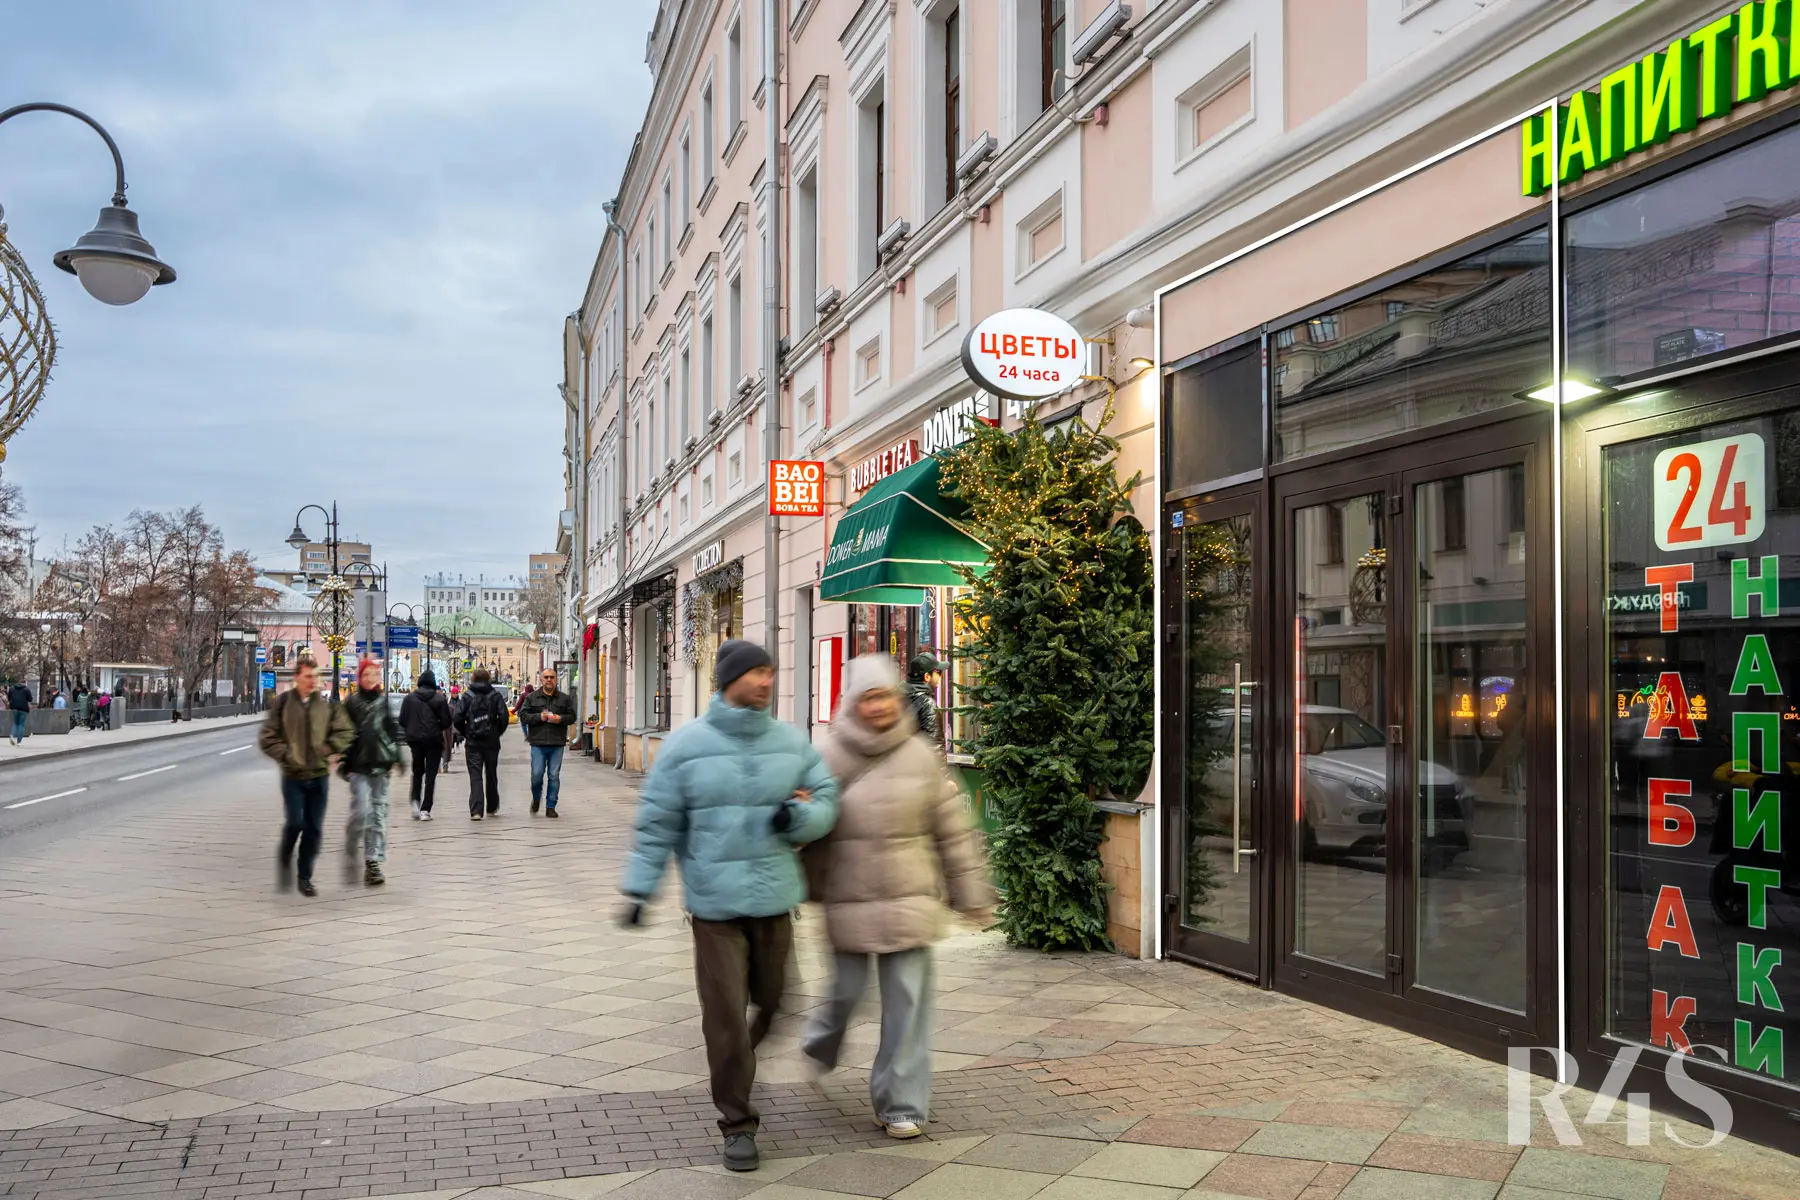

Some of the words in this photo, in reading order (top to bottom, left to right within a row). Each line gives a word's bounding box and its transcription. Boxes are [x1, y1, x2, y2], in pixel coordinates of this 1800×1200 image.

[980, 333, 1077, 360] ЦВЕТЫ
[998, 364, 1018, 379] 24
[1023, 369, 1060, 382] часа
[775, 463, 819, 482] BAO
[851, 450, 889, 493] BUBBLE
[891, 439, 913, 475] TEA
[775, 481, 819, 503] BEI
[1666, 443, 1752, 544] 24
[775, 504, 800, 512] BOBA
[801, 504, 819, 513] TEA
[860, 524, 890, 553] MANIA
[1643, 561, 1701, 1056] ТАБАК
[1730, 554, 1785, 1079] НАПИТКИ
